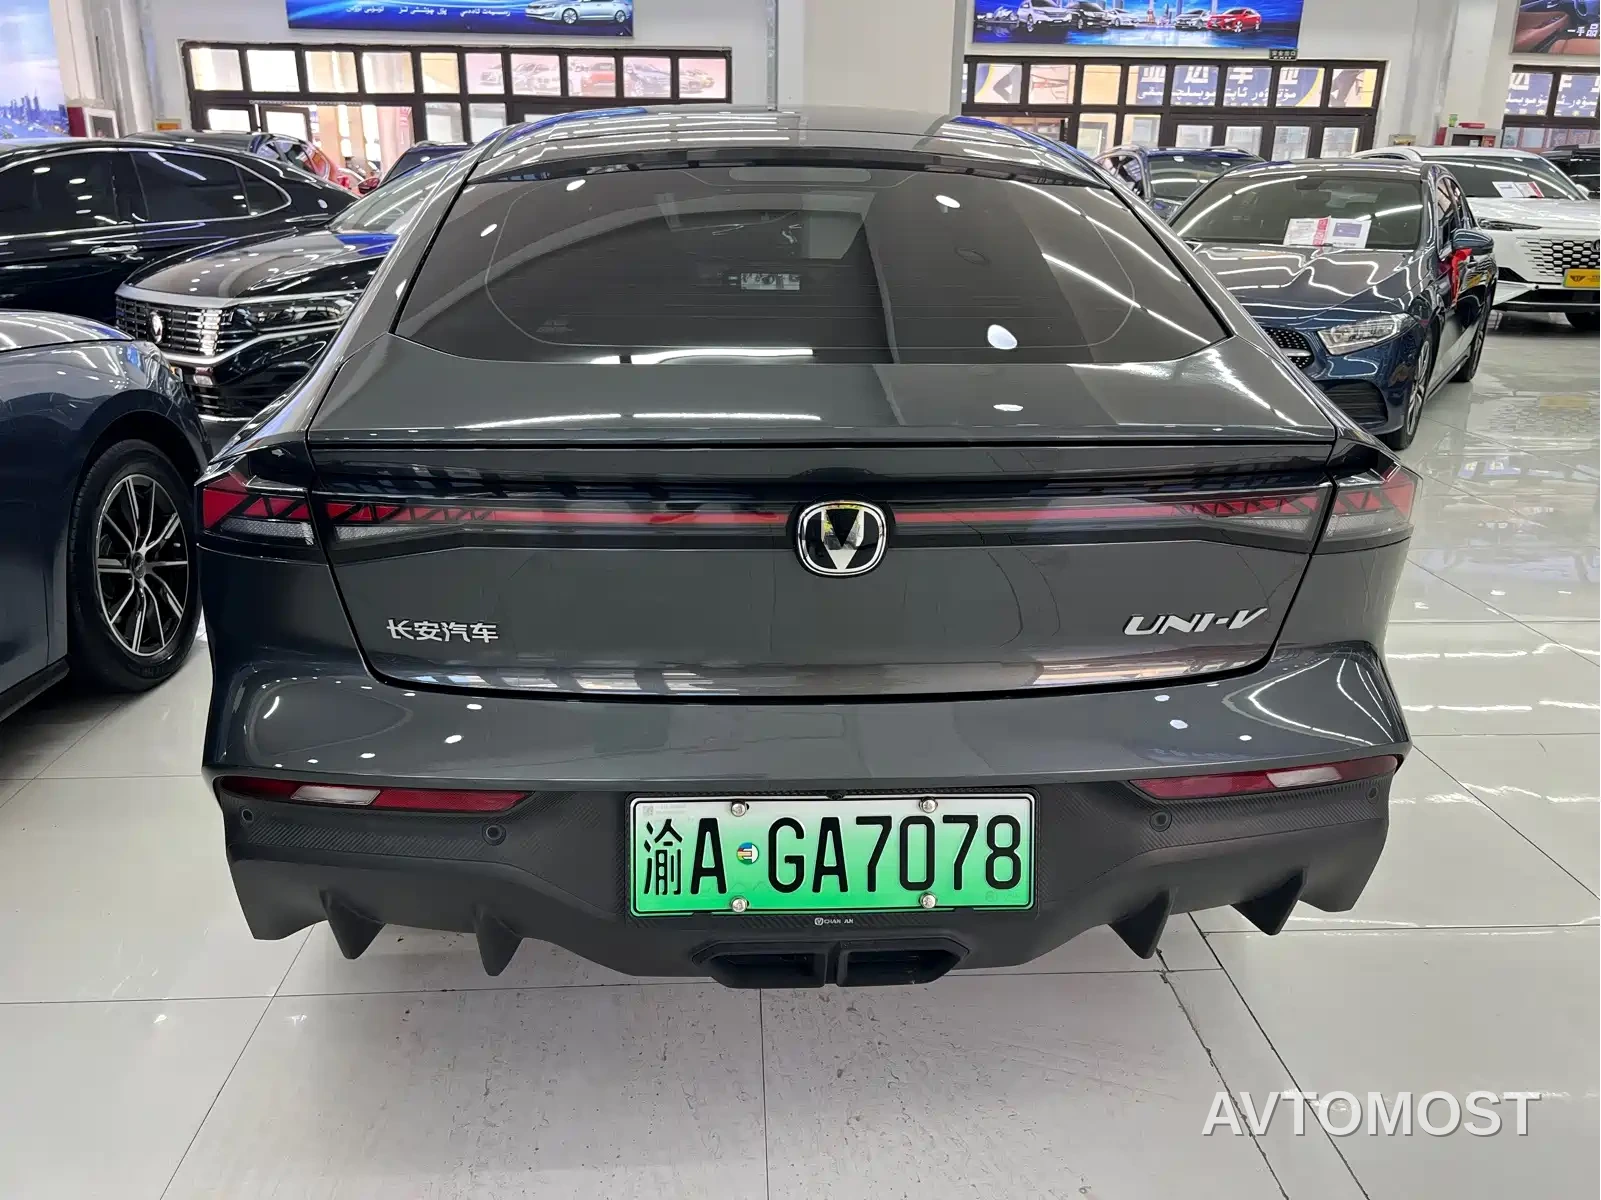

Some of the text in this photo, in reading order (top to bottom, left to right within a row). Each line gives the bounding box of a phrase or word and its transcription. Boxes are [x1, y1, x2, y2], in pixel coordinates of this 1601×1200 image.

[1567, 23, 1600, 37] 一手品
[386, 619, 499, 643] 长安汽车
[1123, 606, 1268, 636] UNI-V
